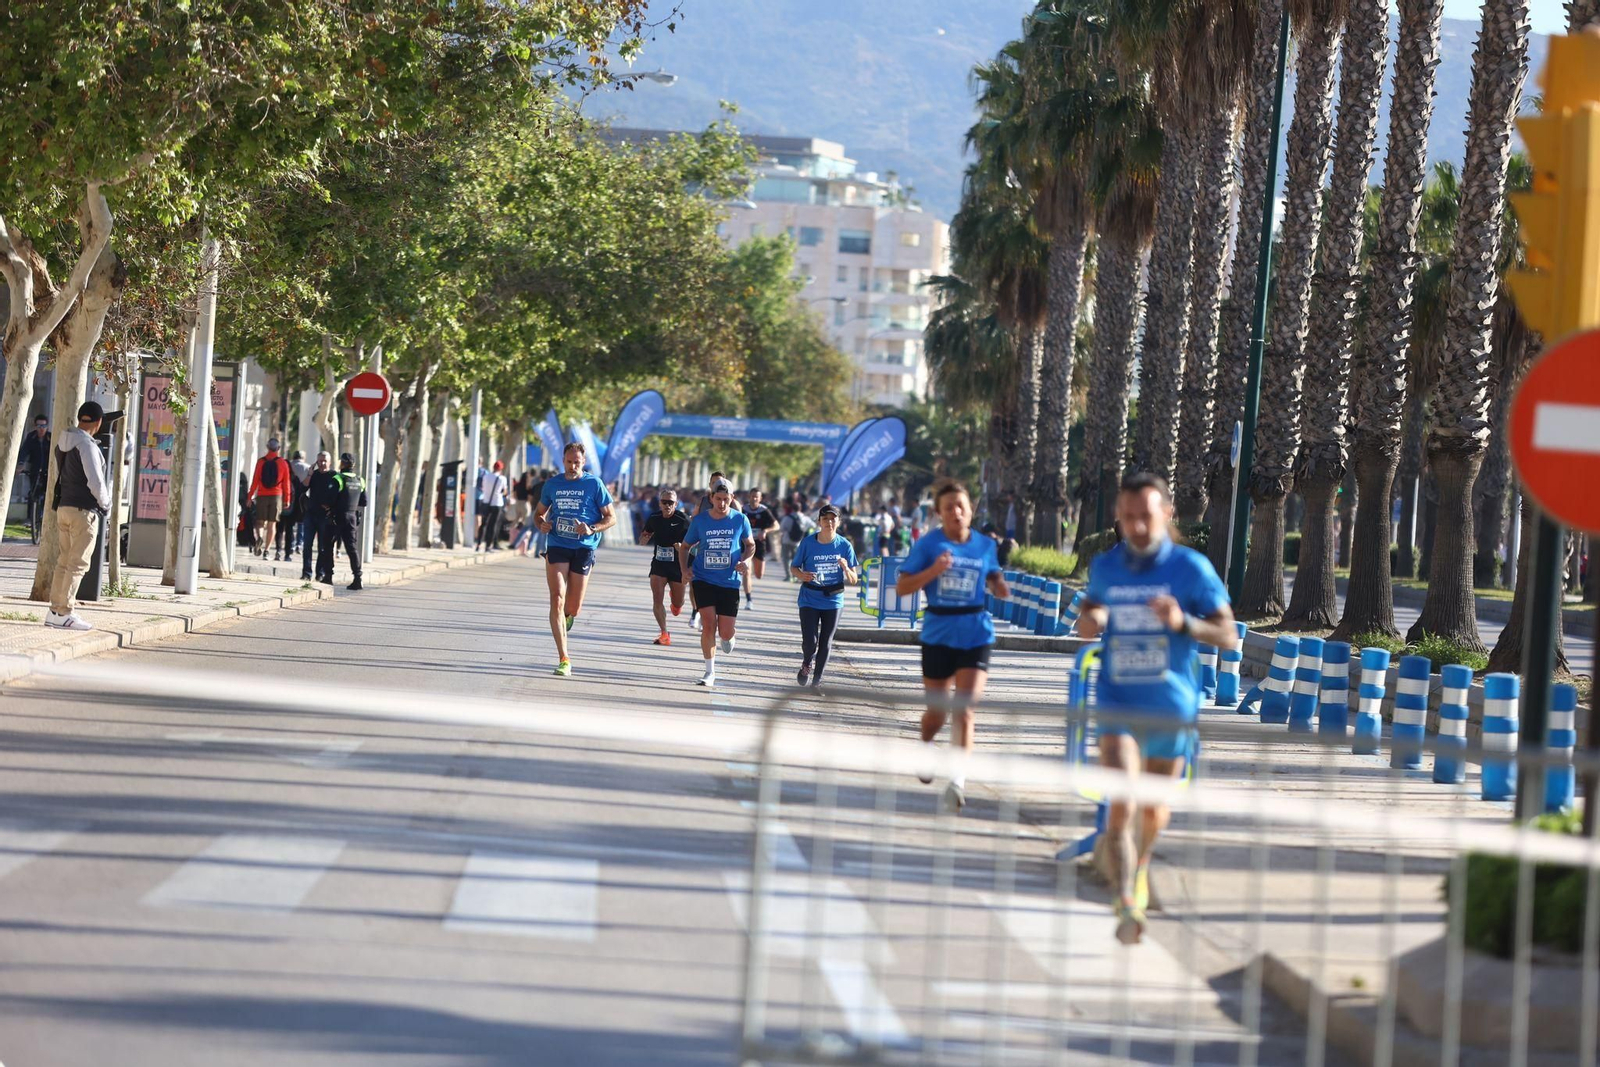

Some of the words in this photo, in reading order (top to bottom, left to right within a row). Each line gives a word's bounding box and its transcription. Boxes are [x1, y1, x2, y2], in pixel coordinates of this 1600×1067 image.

[147, 386, 168, 402] 06
[147, 403, 167, 411] MAYO
[611, 405, 654, 459] mayoral
[789, 426, 841, 439] mayoral
[840, 430, 894, 482] mayoral
[555, 489, 585, 497] mayoral
